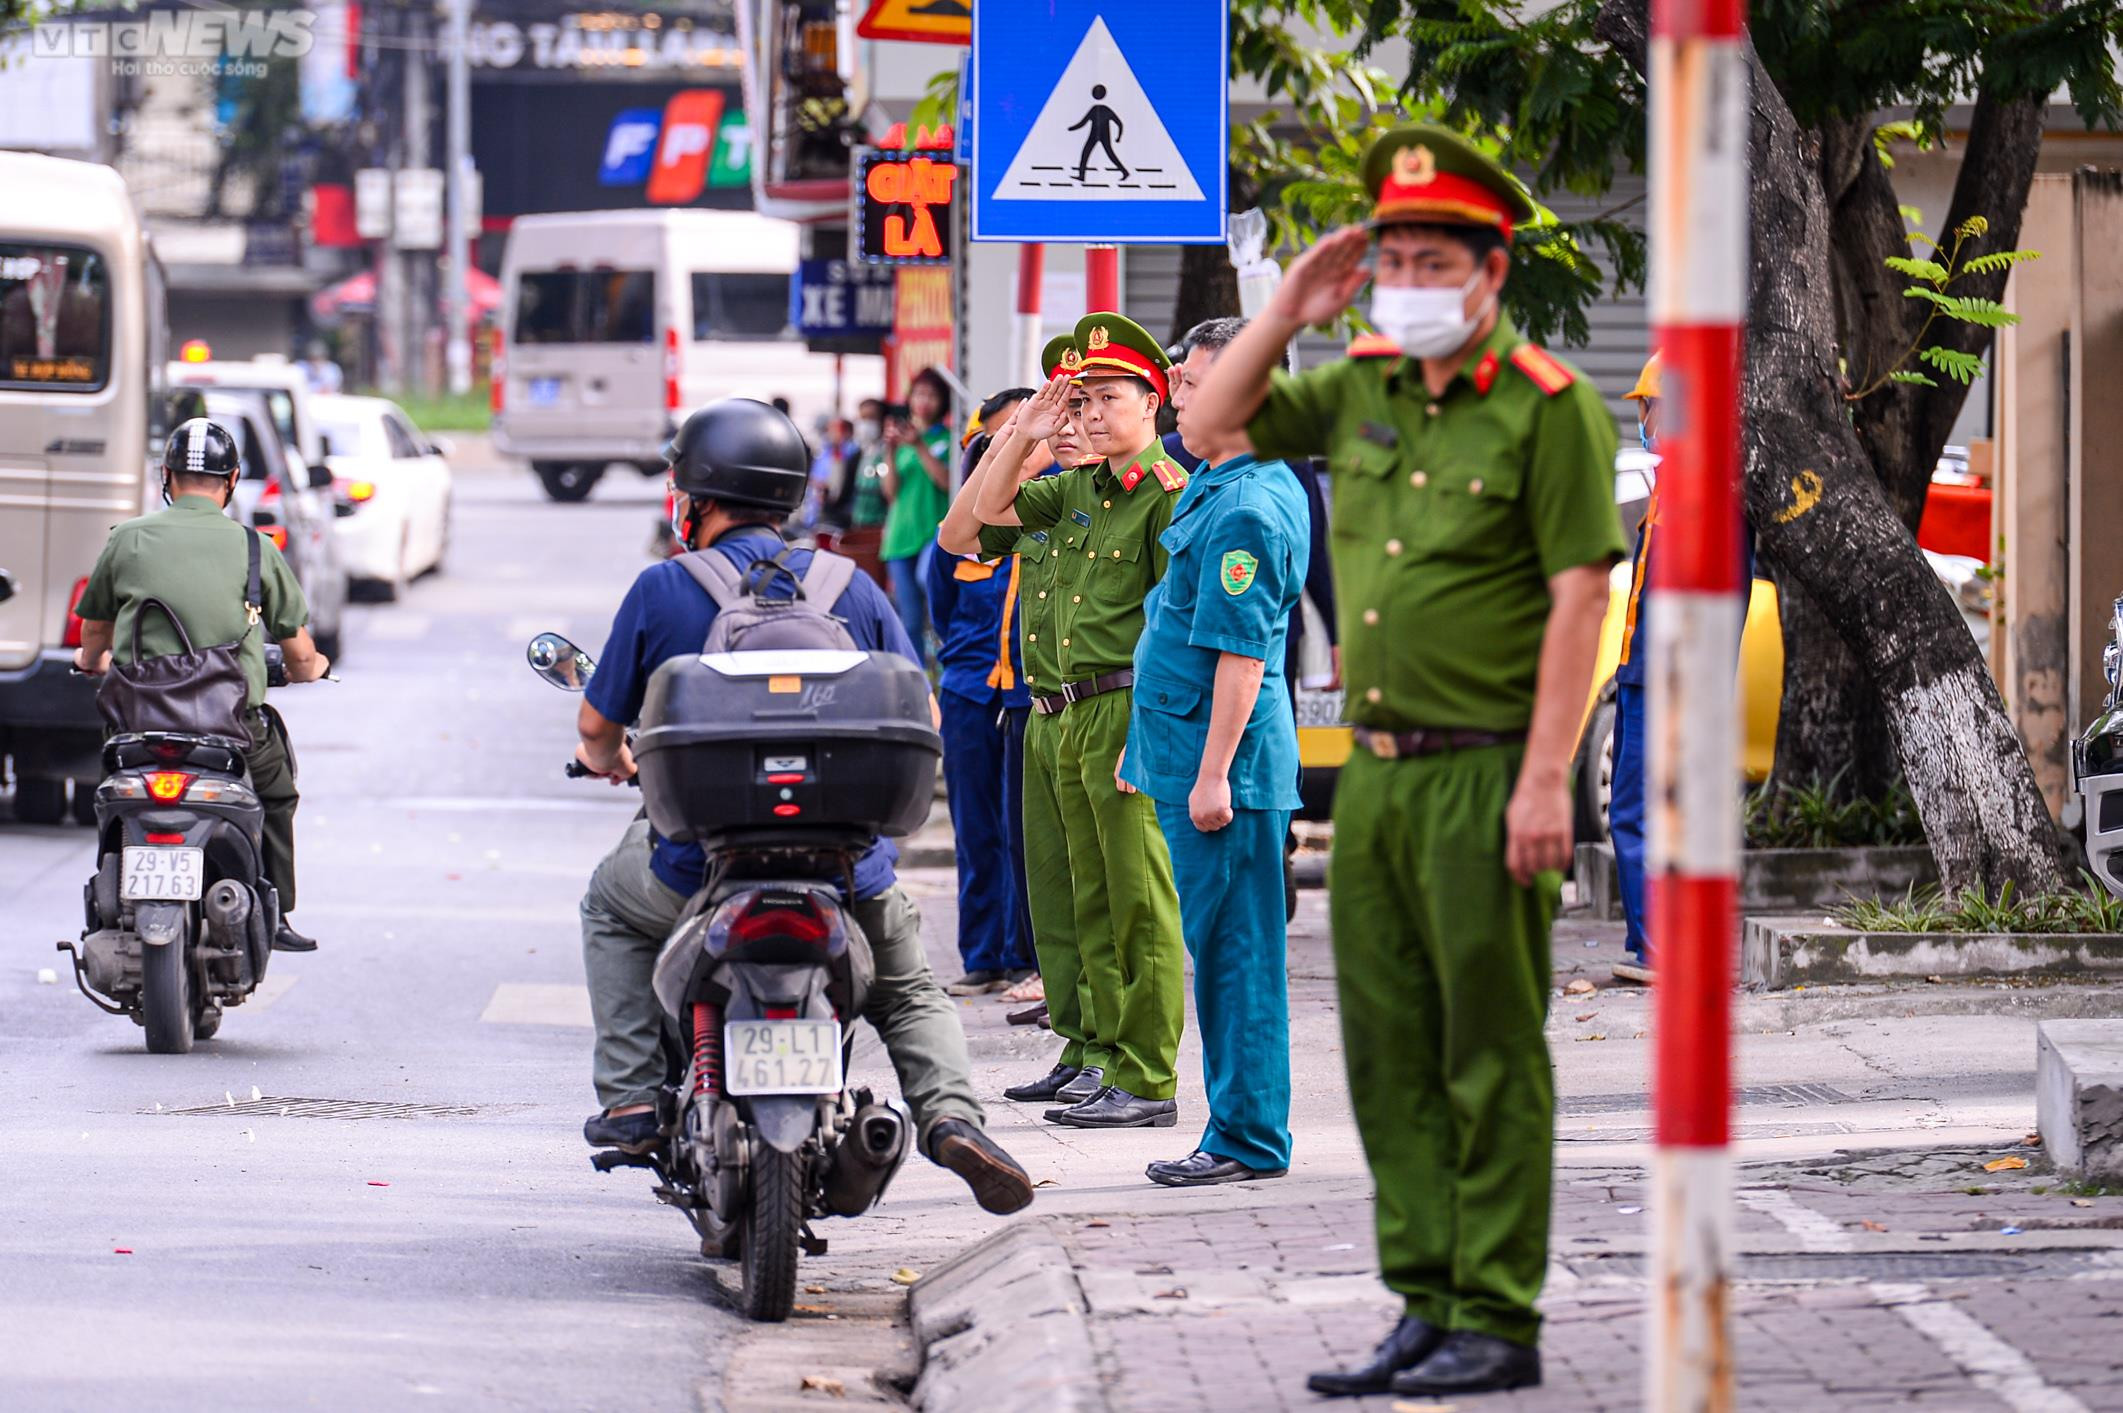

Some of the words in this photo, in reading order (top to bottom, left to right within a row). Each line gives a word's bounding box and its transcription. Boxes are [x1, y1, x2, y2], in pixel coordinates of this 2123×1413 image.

[605, 122, 752, 170] FPT
[128, 874, 194, 896] 217.63
[744, 1024, 819, 1054] 29-L1
[736, 1057, 832, 1088] 461.27
